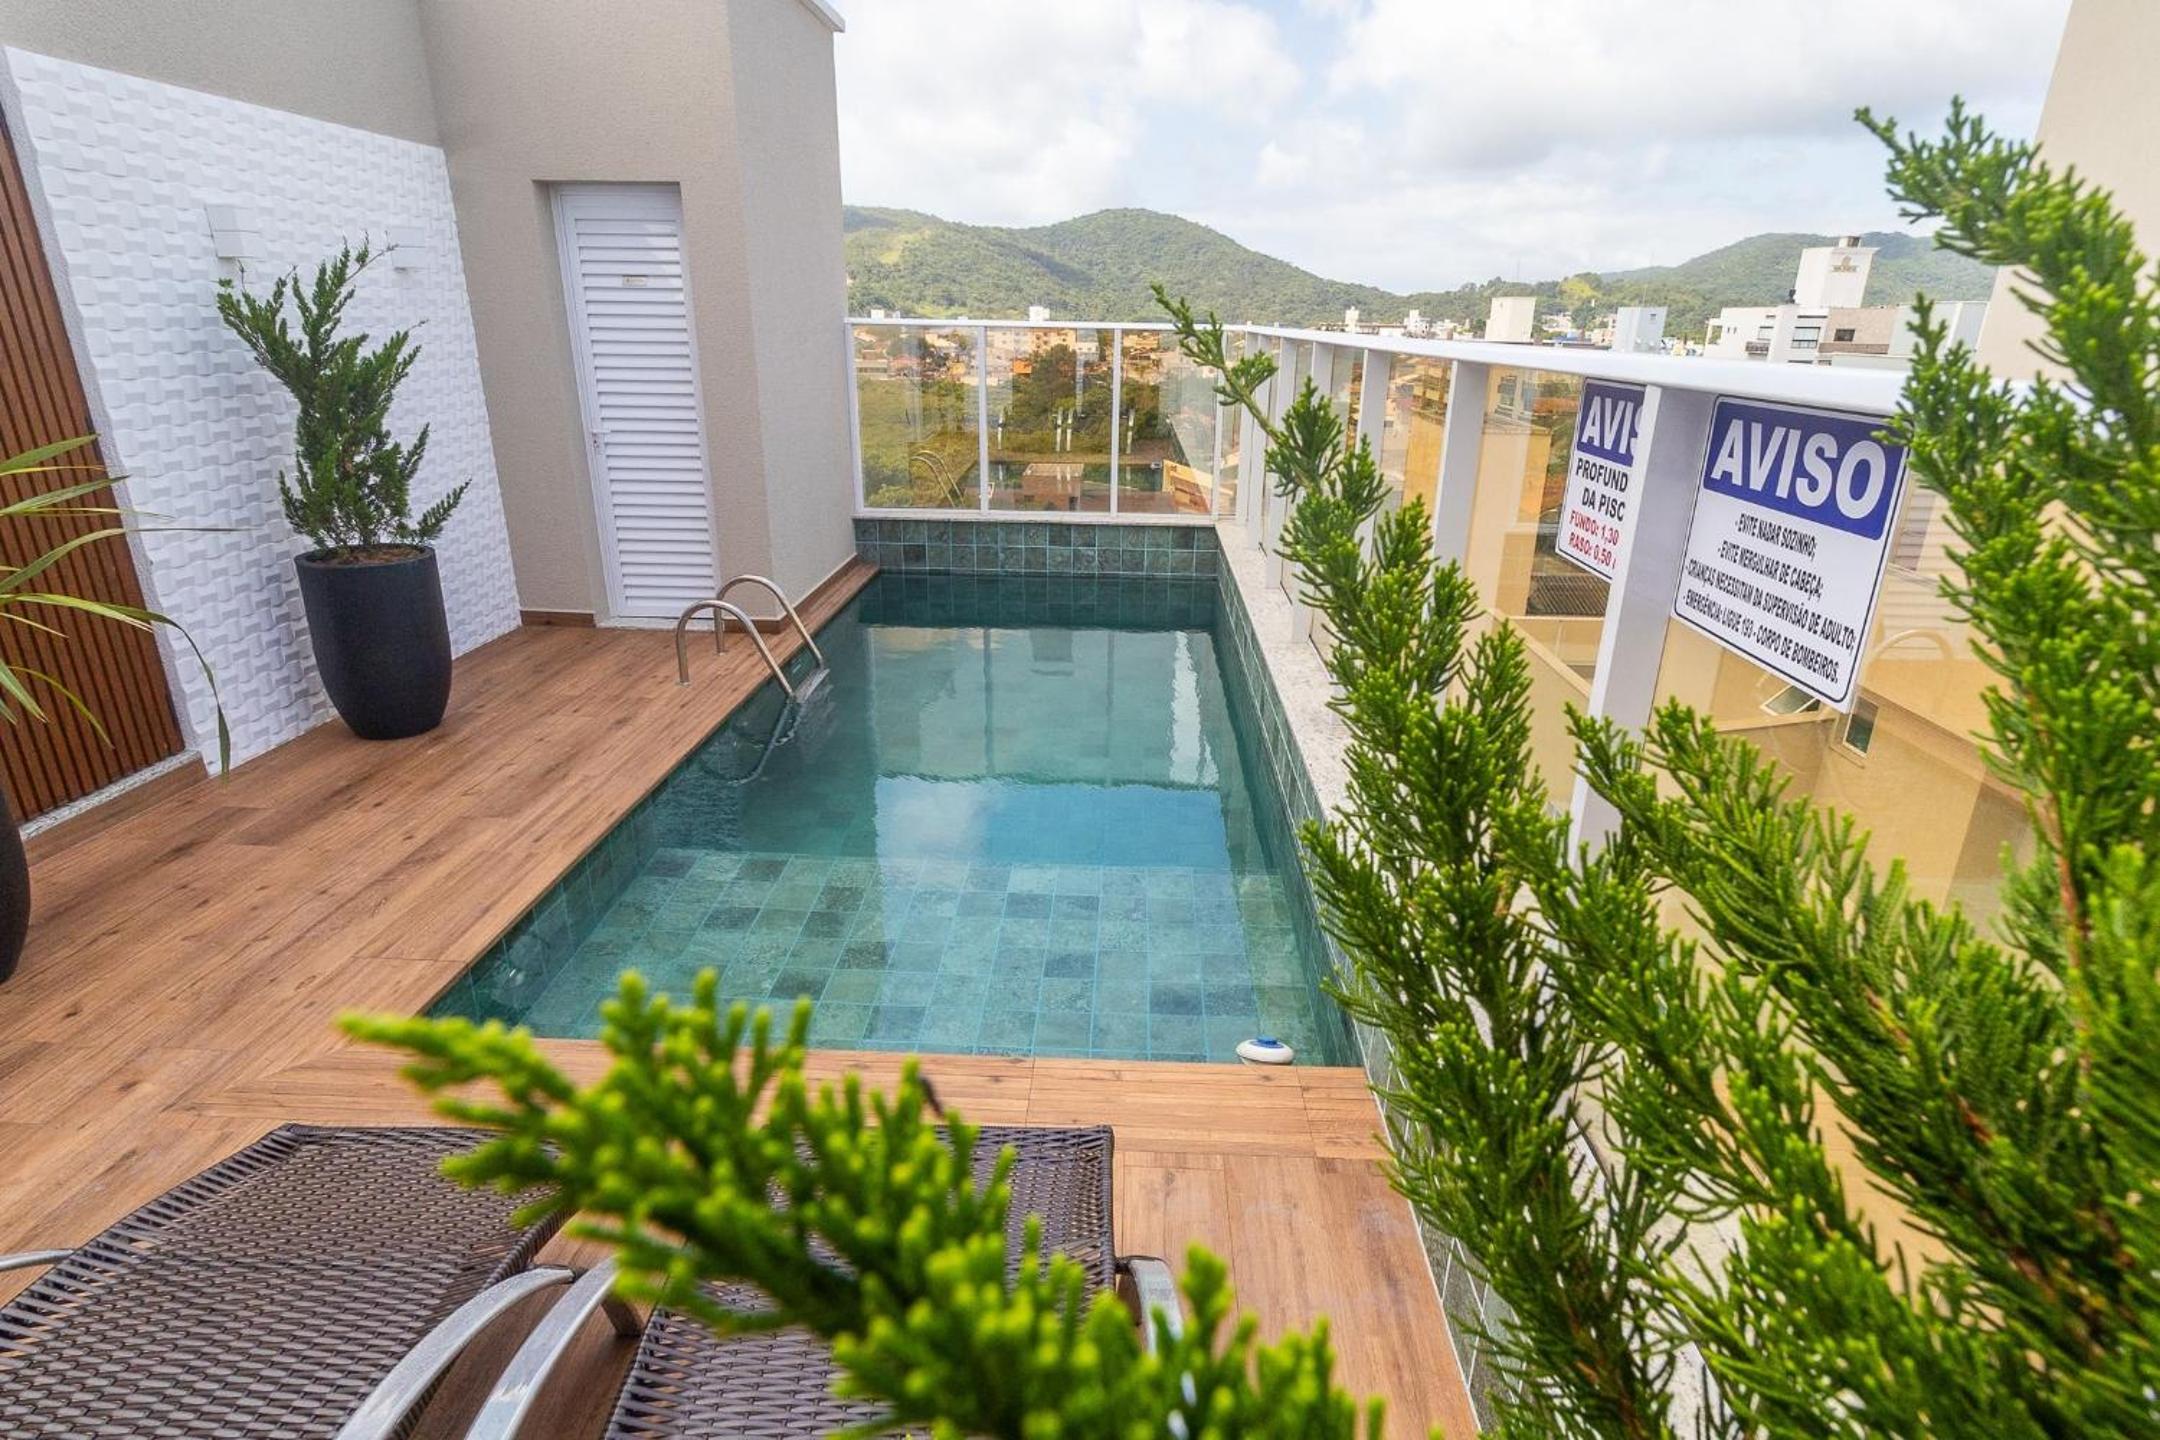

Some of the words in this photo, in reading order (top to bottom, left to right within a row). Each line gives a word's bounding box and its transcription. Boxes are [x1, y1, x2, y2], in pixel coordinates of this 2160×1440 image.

[1711, 418, 1886, 520] AVISO
[1582, 487, 1596, 510] DA
[1756, 519, 1782, 545] NADAR
[1738, 548, 1780, 580] MERGULHAR
[1778, 563, 1791, 585] DE
[1715, 571, 1754, 603] NECESSITAM
[1752, 587, 1763, 609] DA
[1762, 592, 1809, 629] SUPERVISÃO
[1808, 612, 1822, 635] DE
[1722, 607, 1742, 632] LIGUE
[1756, 625, 1781, 653] CORPO
[1780, 636, 1793, 659] DE
